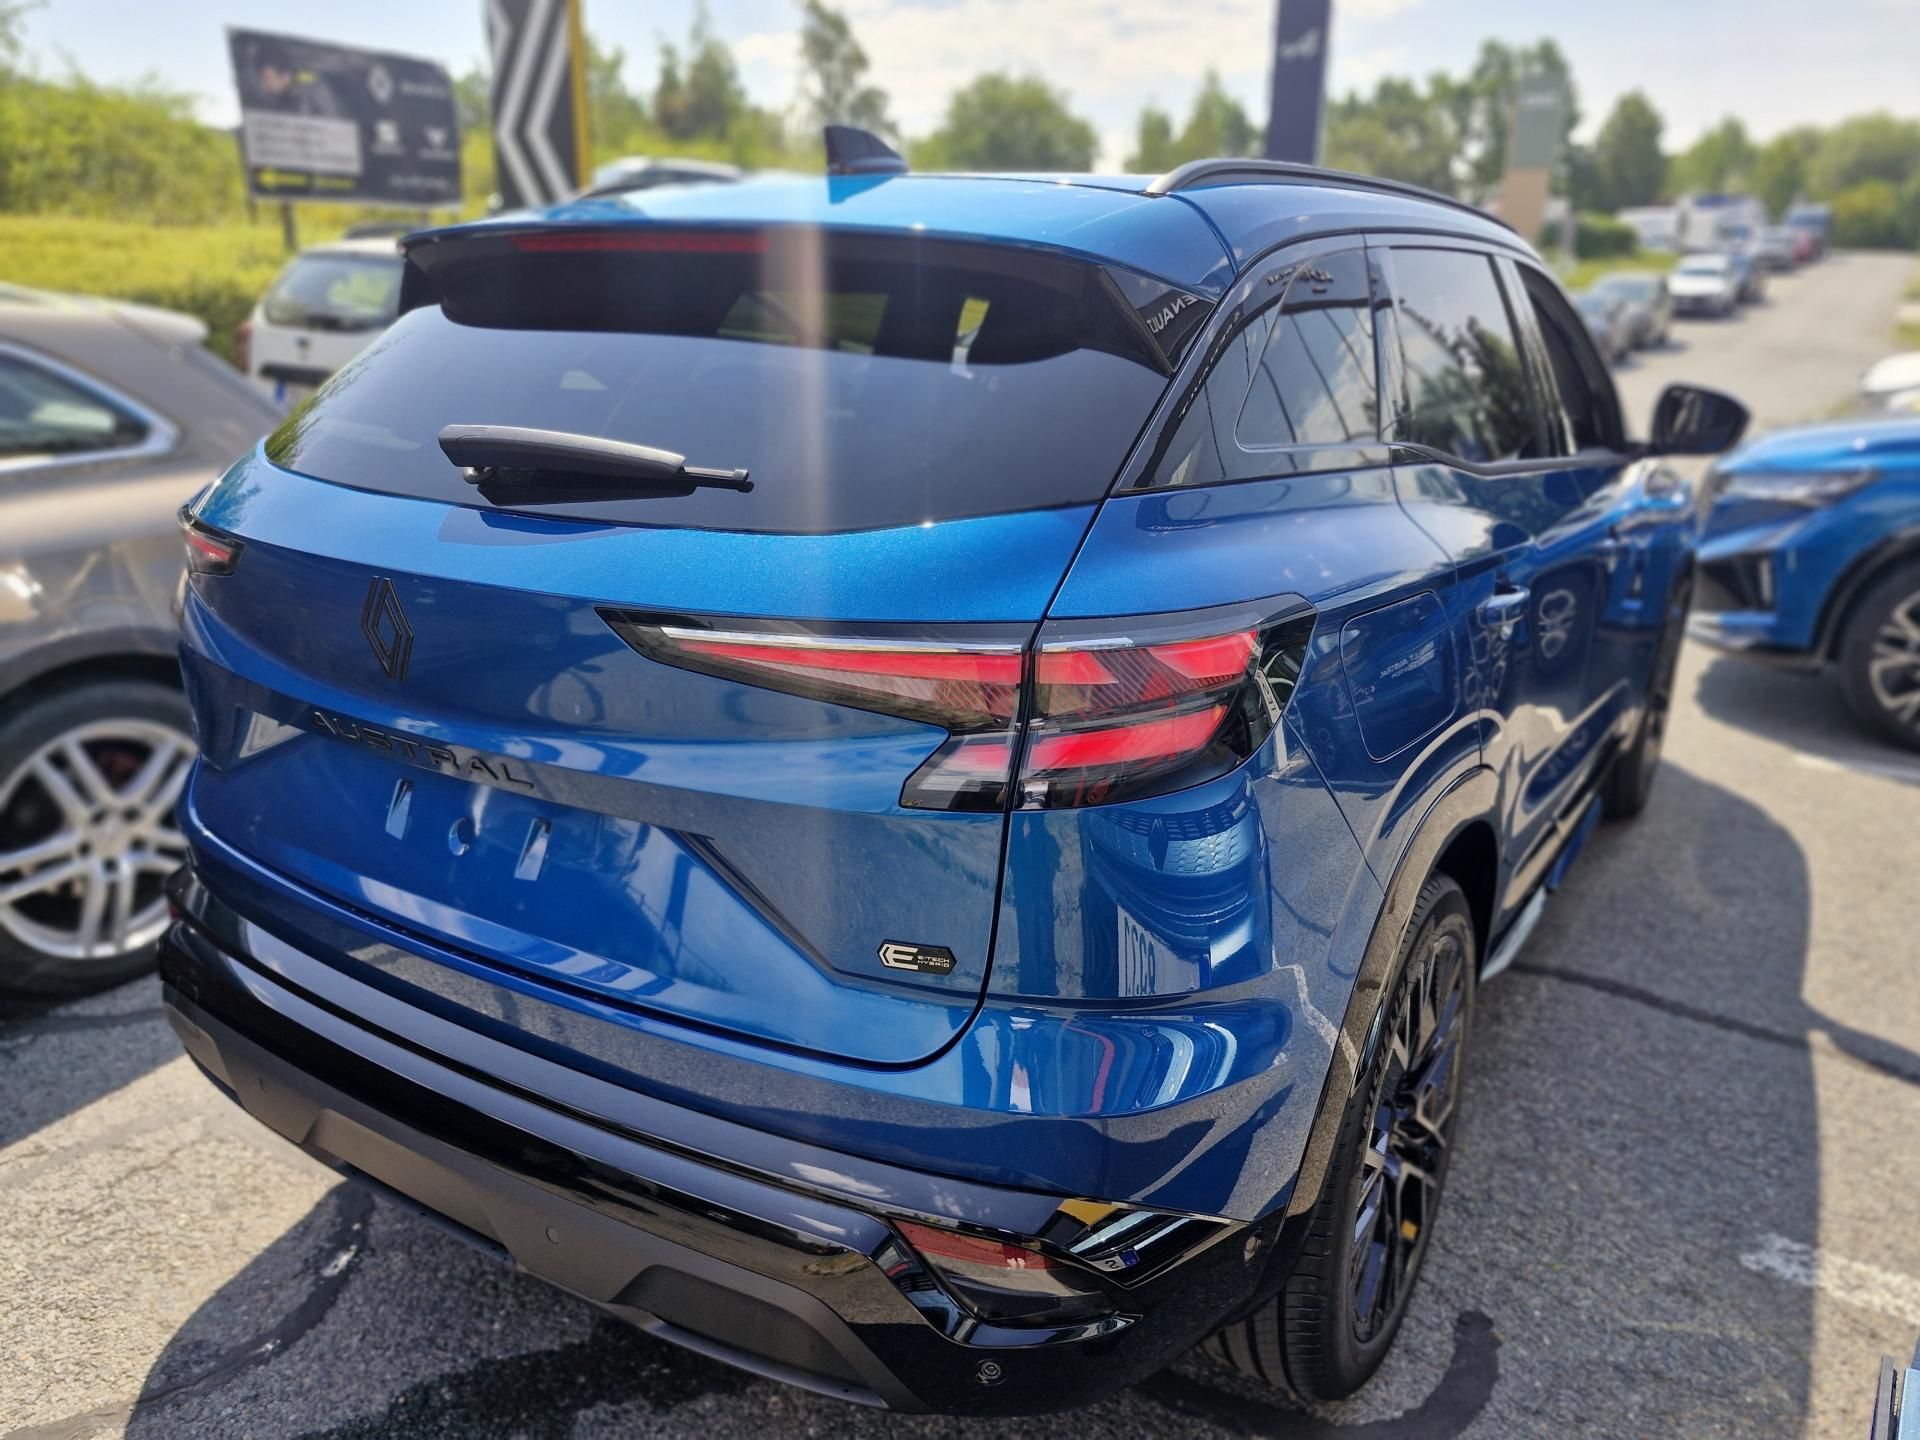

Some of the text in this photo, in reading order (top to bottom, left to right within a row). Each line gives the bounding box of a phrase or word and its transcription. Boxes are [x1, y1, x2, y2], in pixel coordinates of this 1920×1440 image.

[313, 711, 535, 789] AUSTRAL
[917, 955, 950, 963] E-TECH
[917, 959, 950, 968] HYBRID
